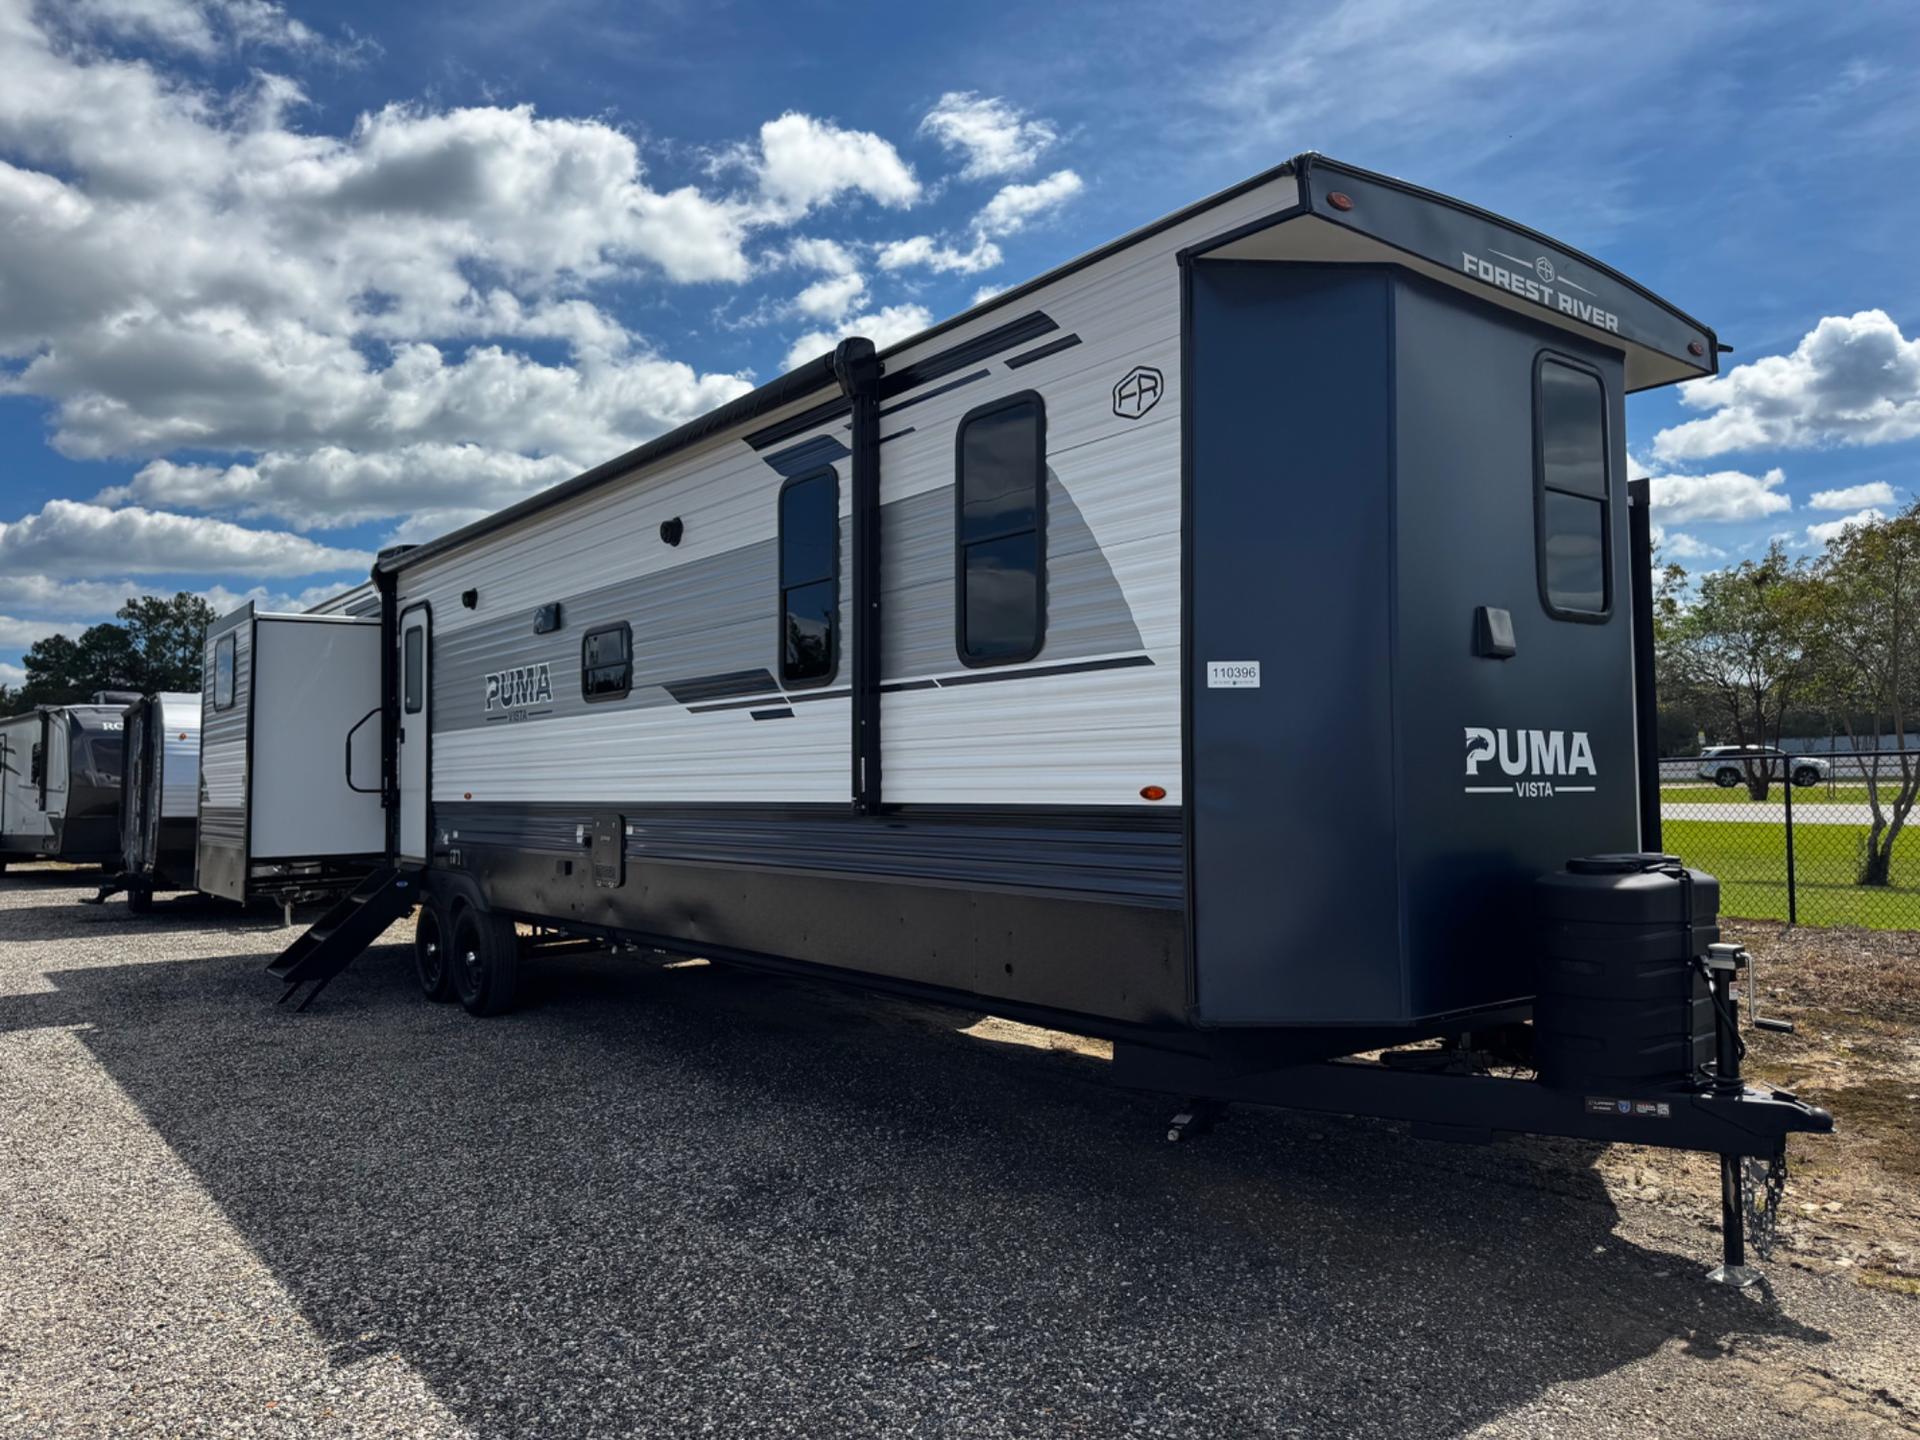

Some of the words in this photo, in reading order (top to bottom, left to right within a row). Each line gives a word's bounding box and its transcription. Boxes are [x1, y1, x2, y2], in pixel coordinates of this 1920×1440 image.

[1462, 251, 1553, 305] FOREST
[1557, 291, 1619, 333] RIVER
[484, 662, 553, 712] PUMA
[1213, 666, 1256, 678] 110396
[507, 709, 528, 722] VISTA
[1464, 727, 1597, 776] PUMA
[1515, 781, 1553, 797] VISTA
